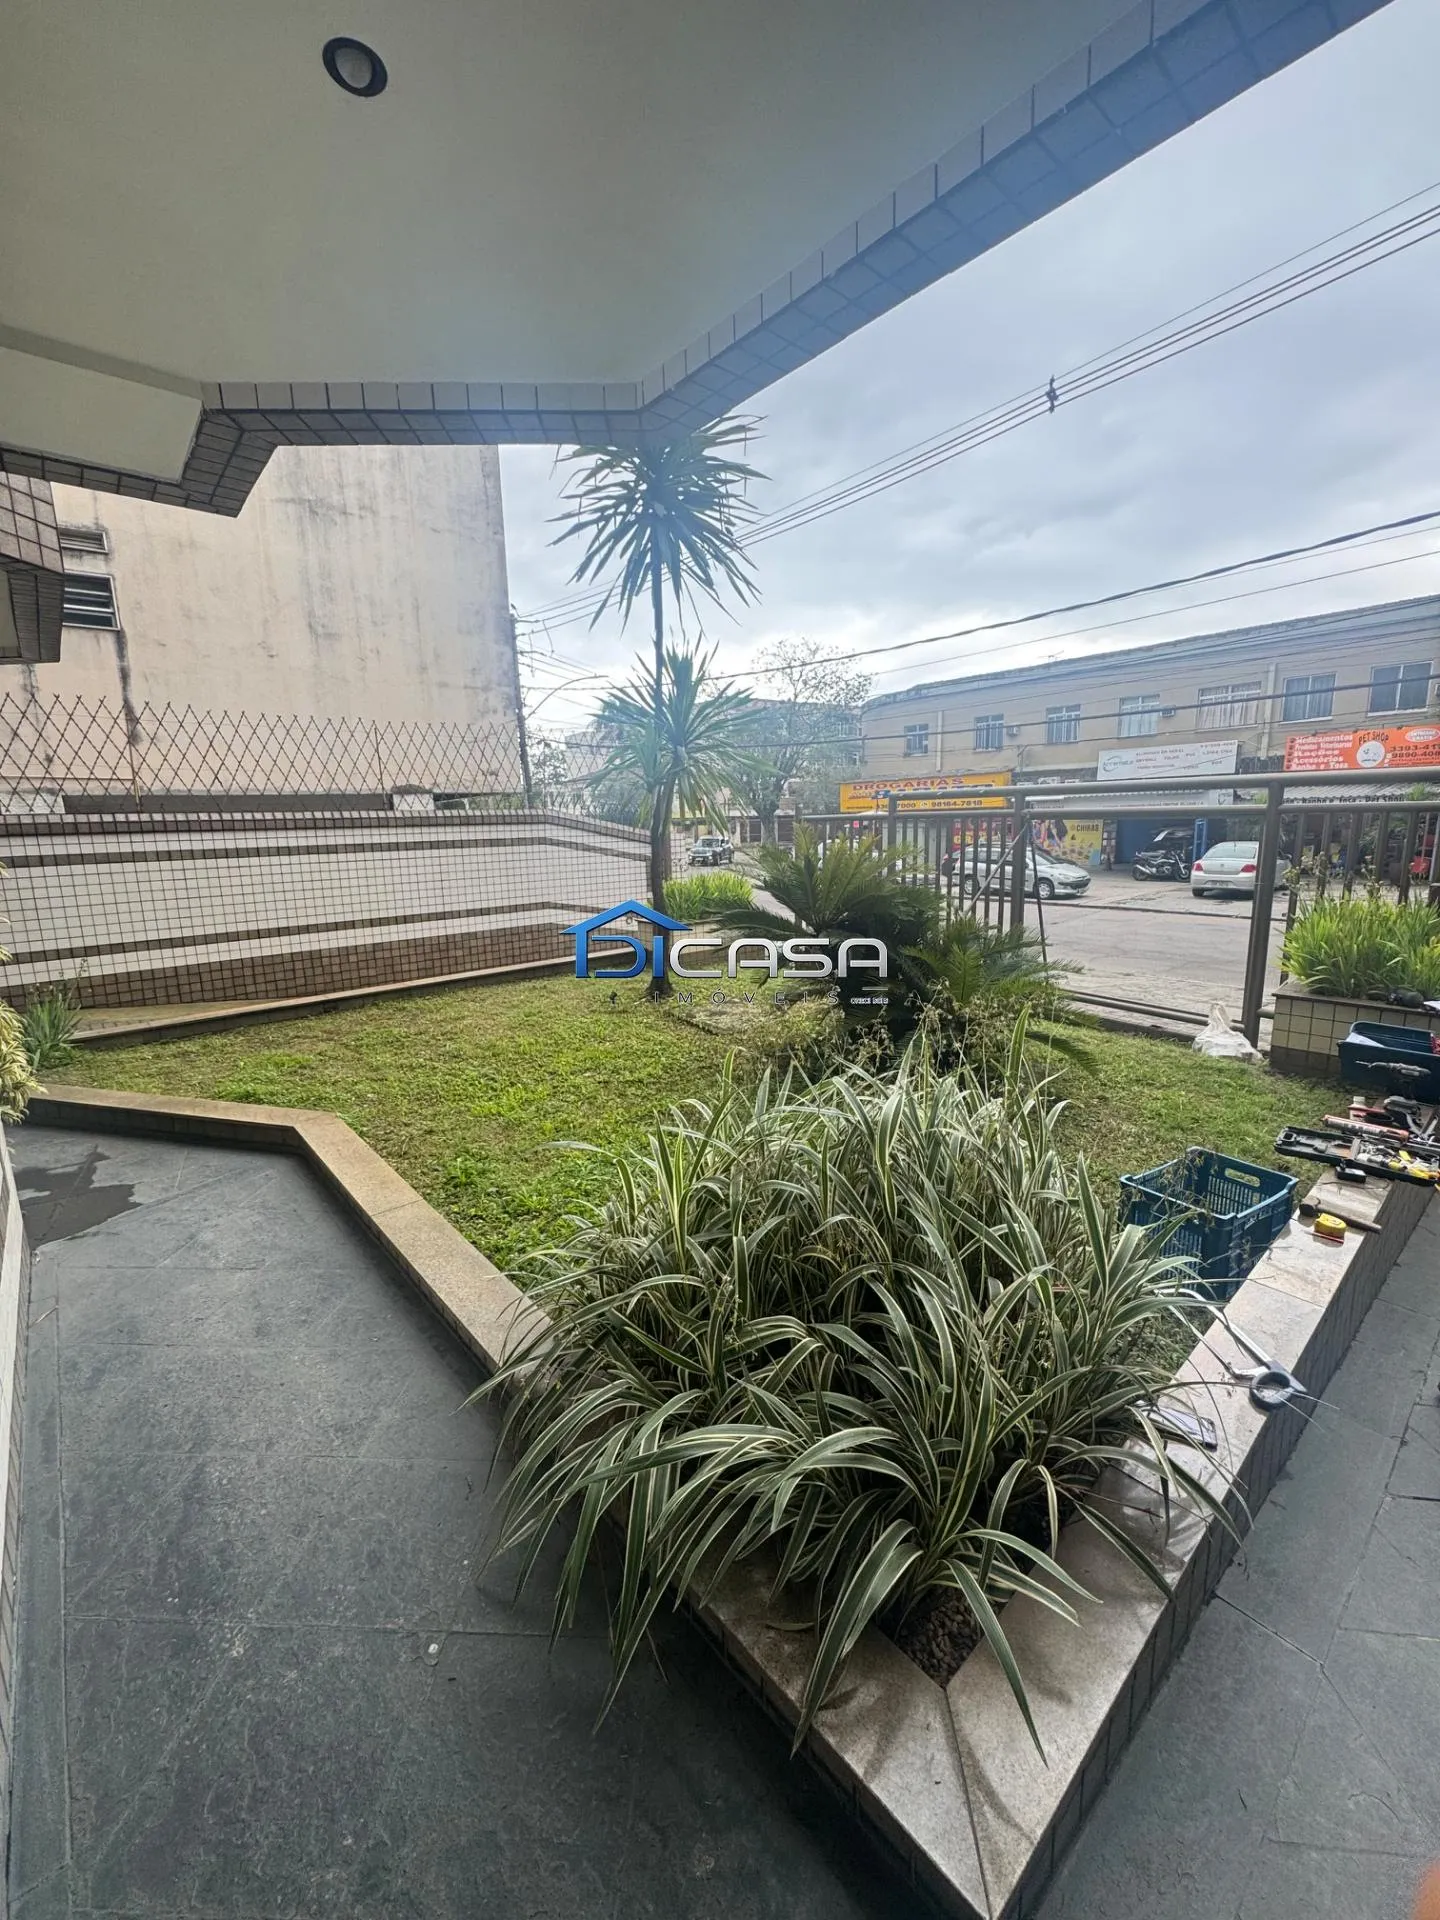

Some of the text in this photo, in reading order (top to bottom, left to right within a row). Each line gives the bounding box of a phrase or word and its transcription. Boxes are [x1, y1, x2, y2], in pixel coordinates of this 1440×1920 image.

[1295, 735, 1353, 744] Medicamentos
[1358, 731, 1389, 747] PET SHOP
[1293, 749, 1340, 757] Rações
[1293, 756, 1344, 764] Acessórios
[852, 777, 964, 791] DROGARIAS
